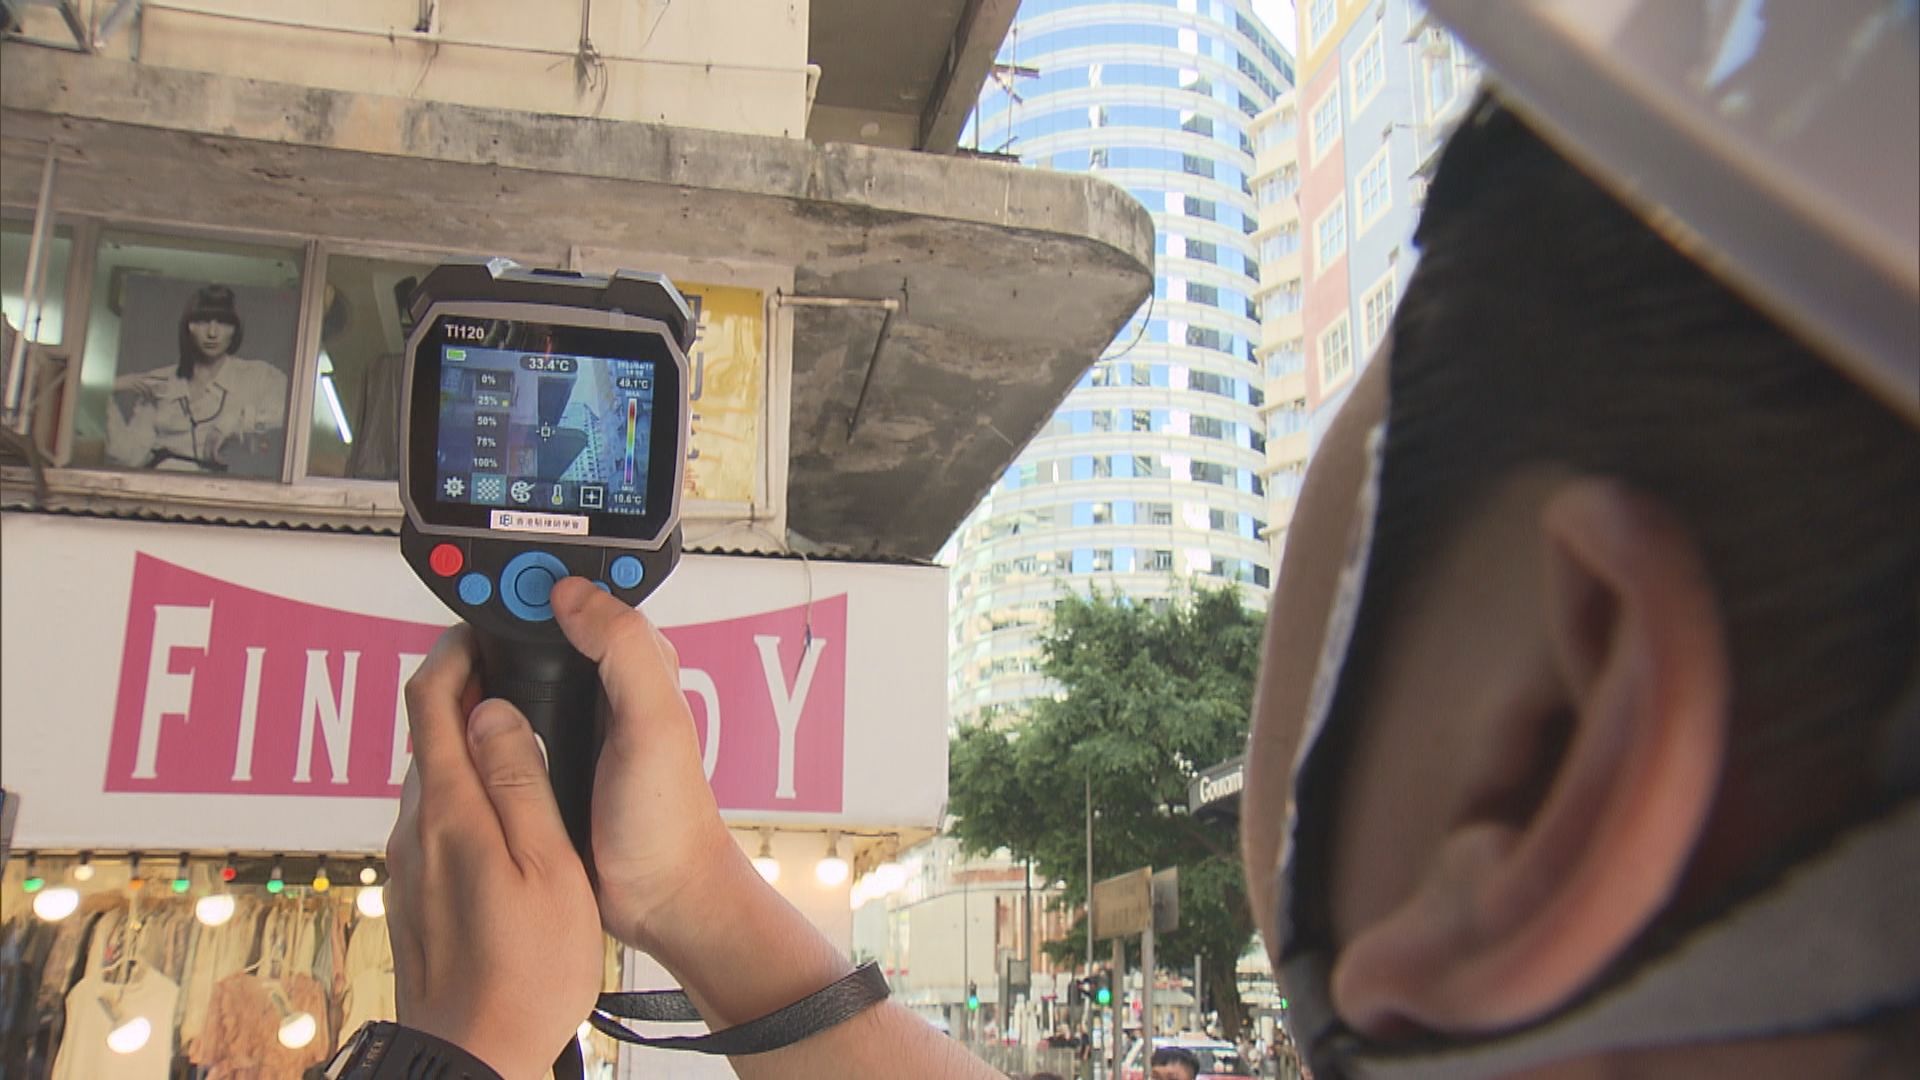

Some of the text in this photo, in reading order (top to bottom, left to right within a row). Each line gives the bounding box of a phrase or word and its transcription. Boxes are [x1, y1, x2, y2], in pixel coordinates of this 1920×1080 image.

[445, 324, 485, 340] TI120
[528, 357, 570, 371] 33.4°C
[481, 374, 496, 385] 0%
[478, 395, 498, 406] 25%
[477, 415, 497, 427] 50%
[474, 457, 498, 468] 100%
